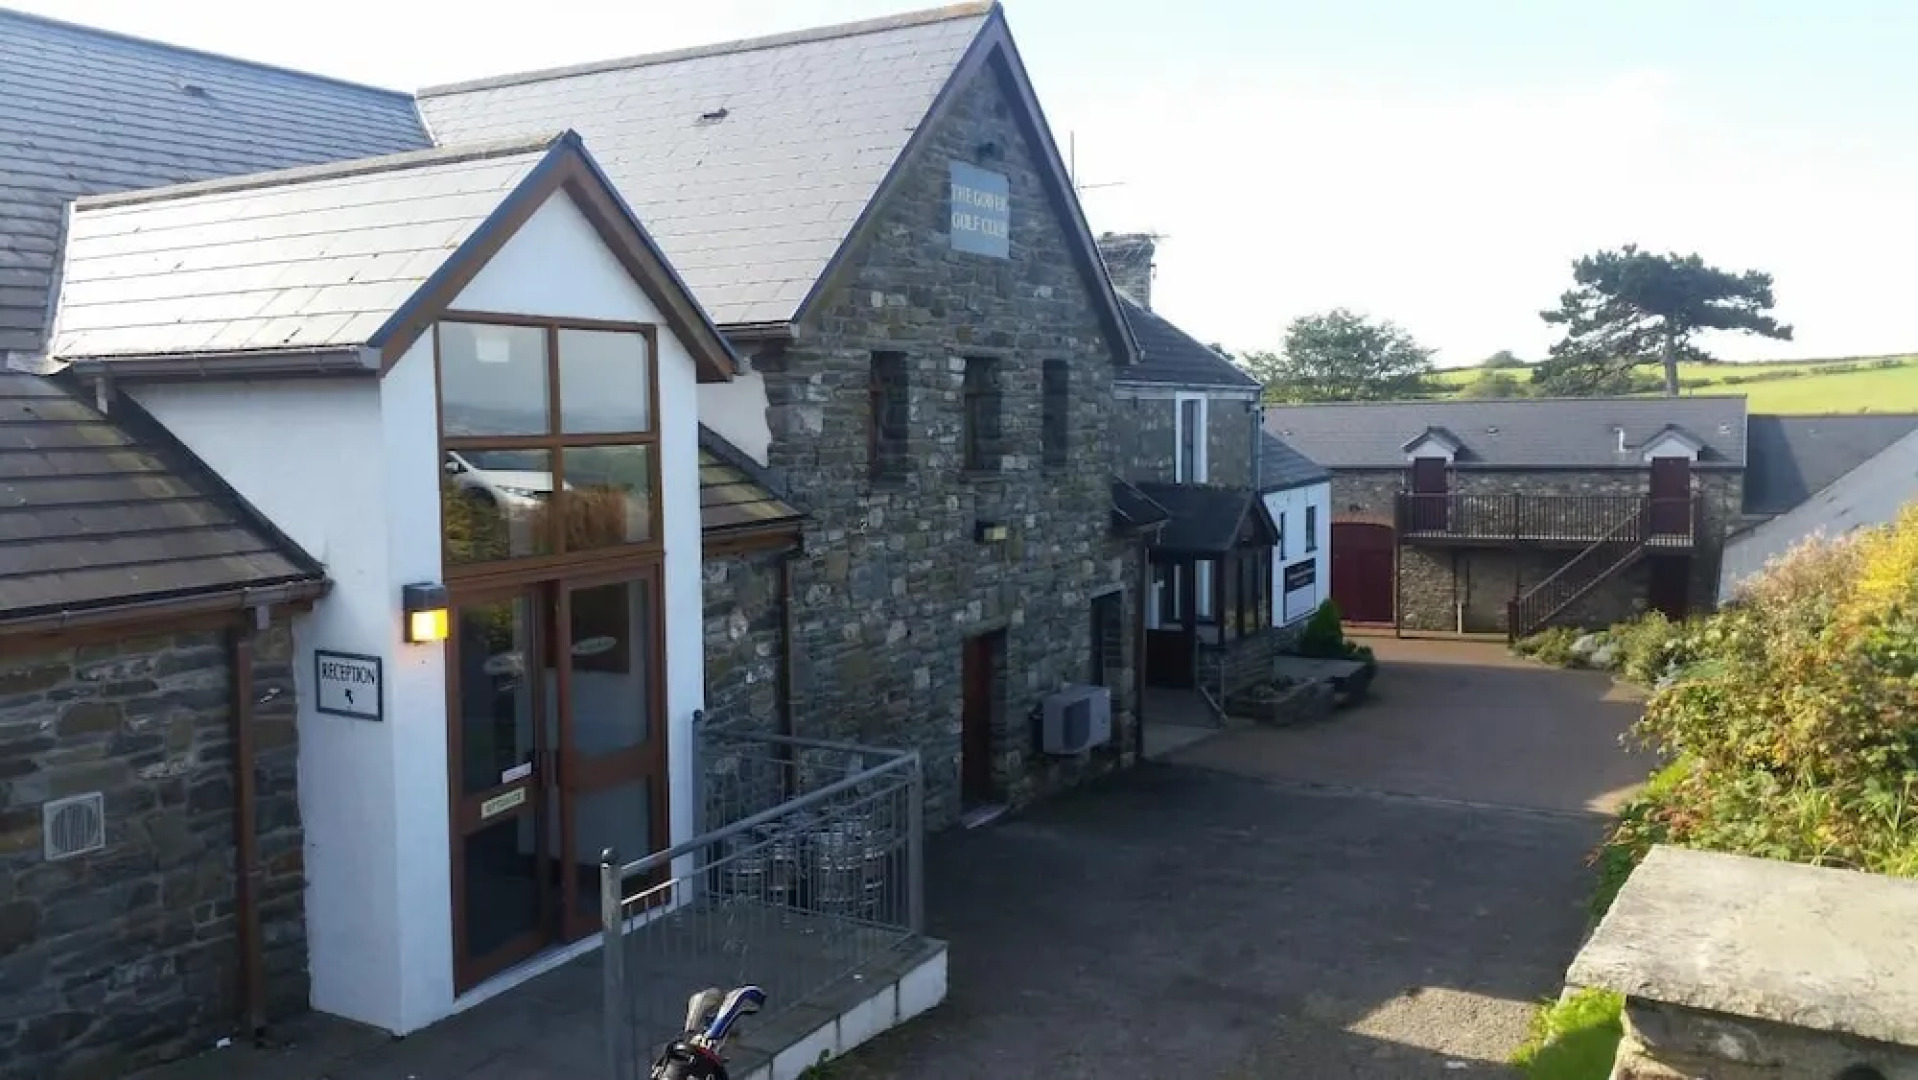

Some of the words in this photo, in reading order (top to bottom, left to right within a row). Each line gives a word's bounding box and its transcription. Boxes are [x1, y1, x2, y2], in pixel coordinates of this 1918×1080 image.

[951, 184, 972, 204] THE
[952, 212, 980, 231] GOLF
[321, 662, 375, 685] RECEPTION
